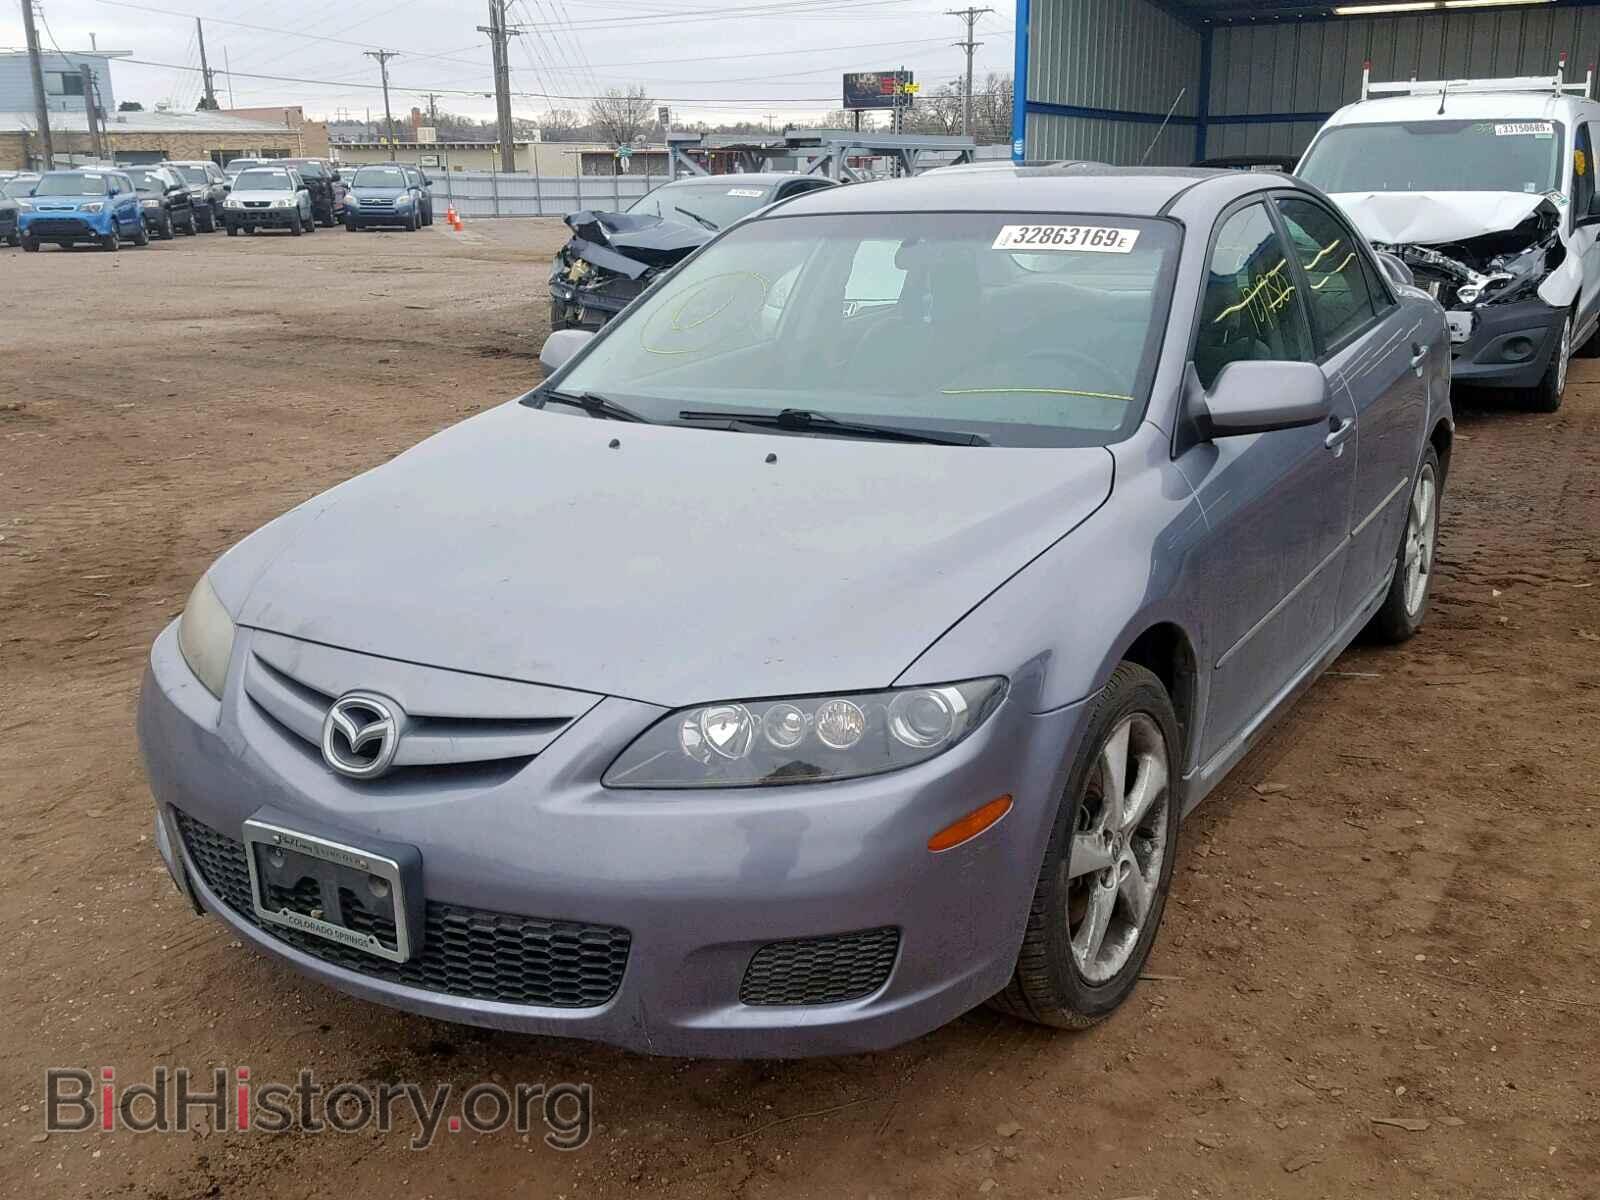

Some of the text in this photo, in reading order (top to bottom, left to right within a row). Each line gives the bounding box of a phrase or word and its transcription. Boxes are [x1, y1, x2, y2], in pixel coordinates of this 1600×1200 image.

[1013, 226, 1120, 247] 32863169
[288, 916, 369, 948] COLORADO SPRINGS
